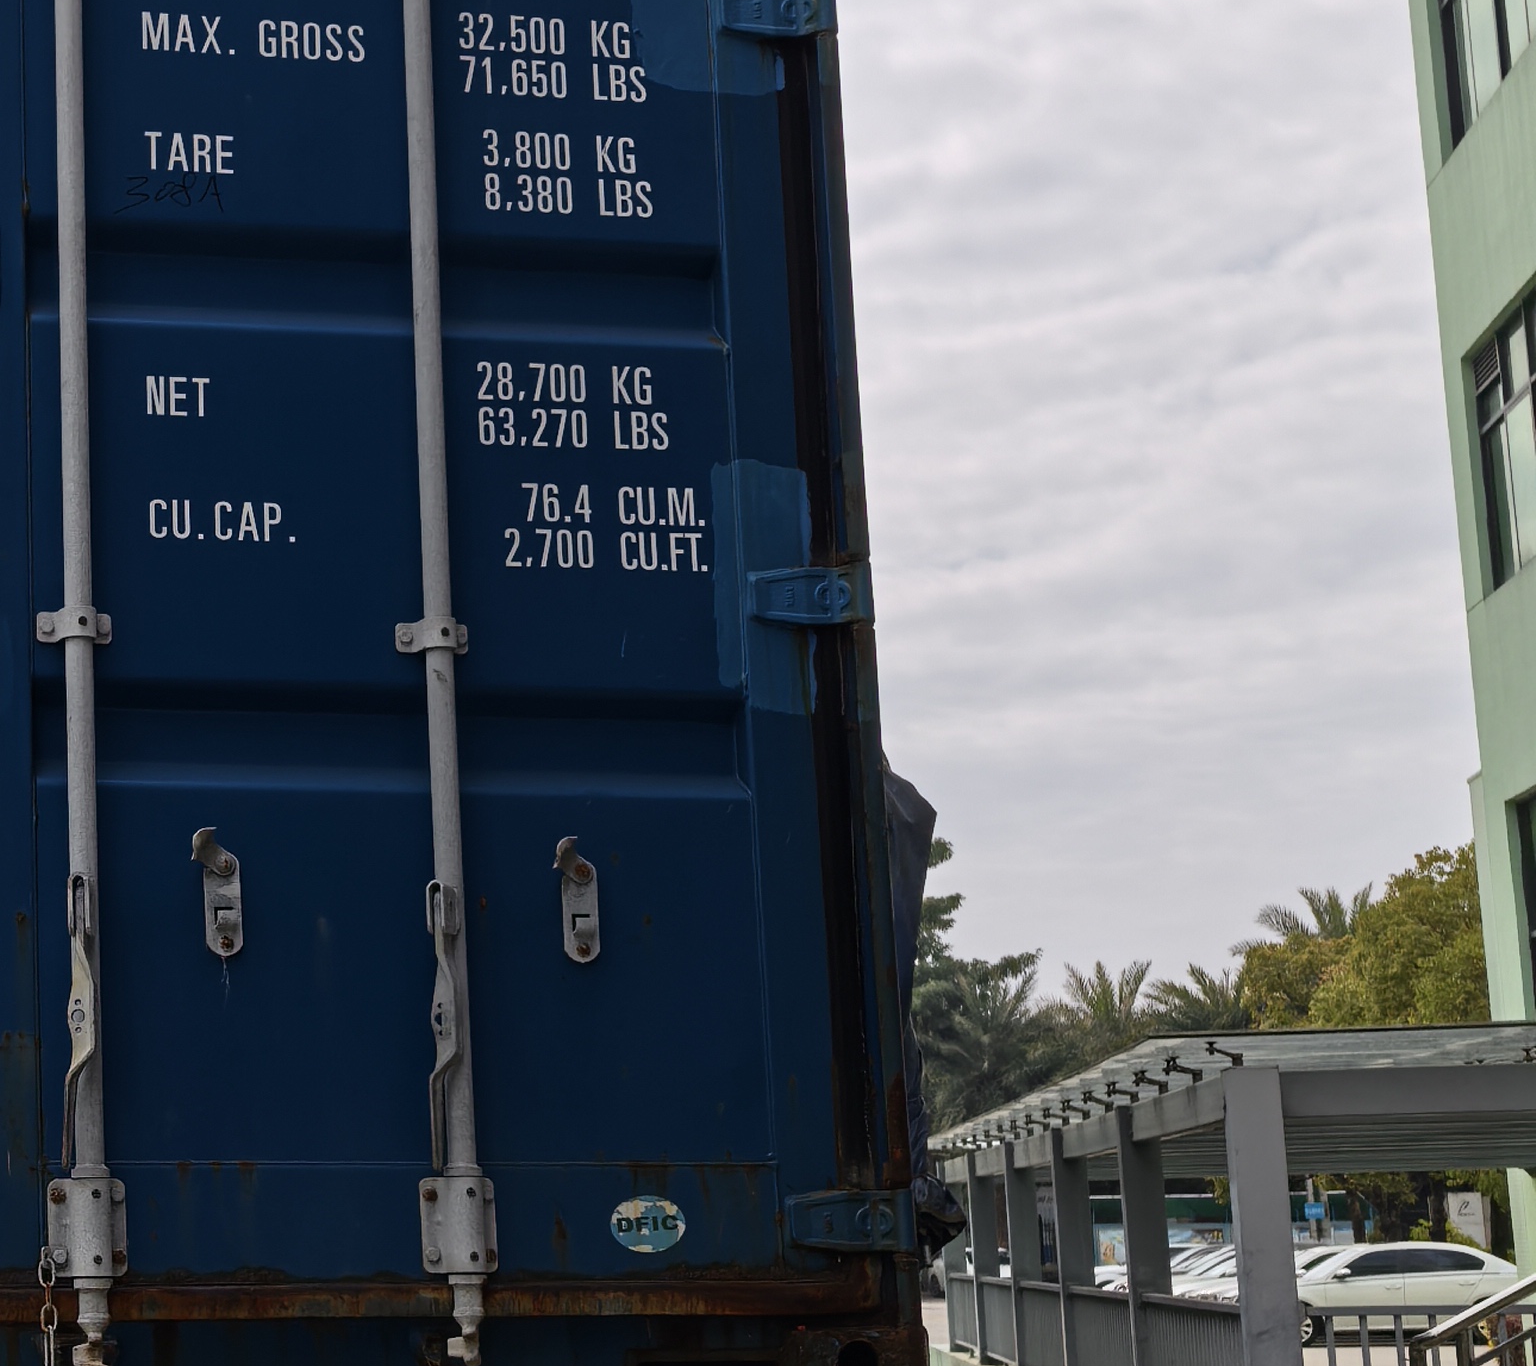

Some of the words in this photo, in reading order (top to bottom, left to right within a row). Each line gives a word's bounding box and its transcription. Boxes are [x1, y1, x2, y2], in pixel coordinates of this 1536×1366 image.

[141, 11, 236, 55] MAX.
[258, 19, 365, 63] GROSS
[458, 12, 565, 56] 32,500
[590, 19, 631, 59] KG
[459, 55, 567, 99] 71,650
[592, 64, 647, 103] LBS
[144, 131, 234, 175] TARE
[482, 128, 571, 171] 3,800
[595, 135, 637, 174] KG
[484, 172, 573, 215] 8,380
[598, 178, 653, 218] LBS
[146, 375, 210, 417] NET
[476, 361, 587, 403] 28,700
[611, 365, 652, 405] KG
[478, 406, 588, 448] 63,270
[613, 410, 669, 451] LBS
[521, 482, 592, 523] 76.4
[618, 486, 706, 527] CU.M.
[504, 528, 594, 569] 2,700
[620, 531, 708, 572] CU.FT.
